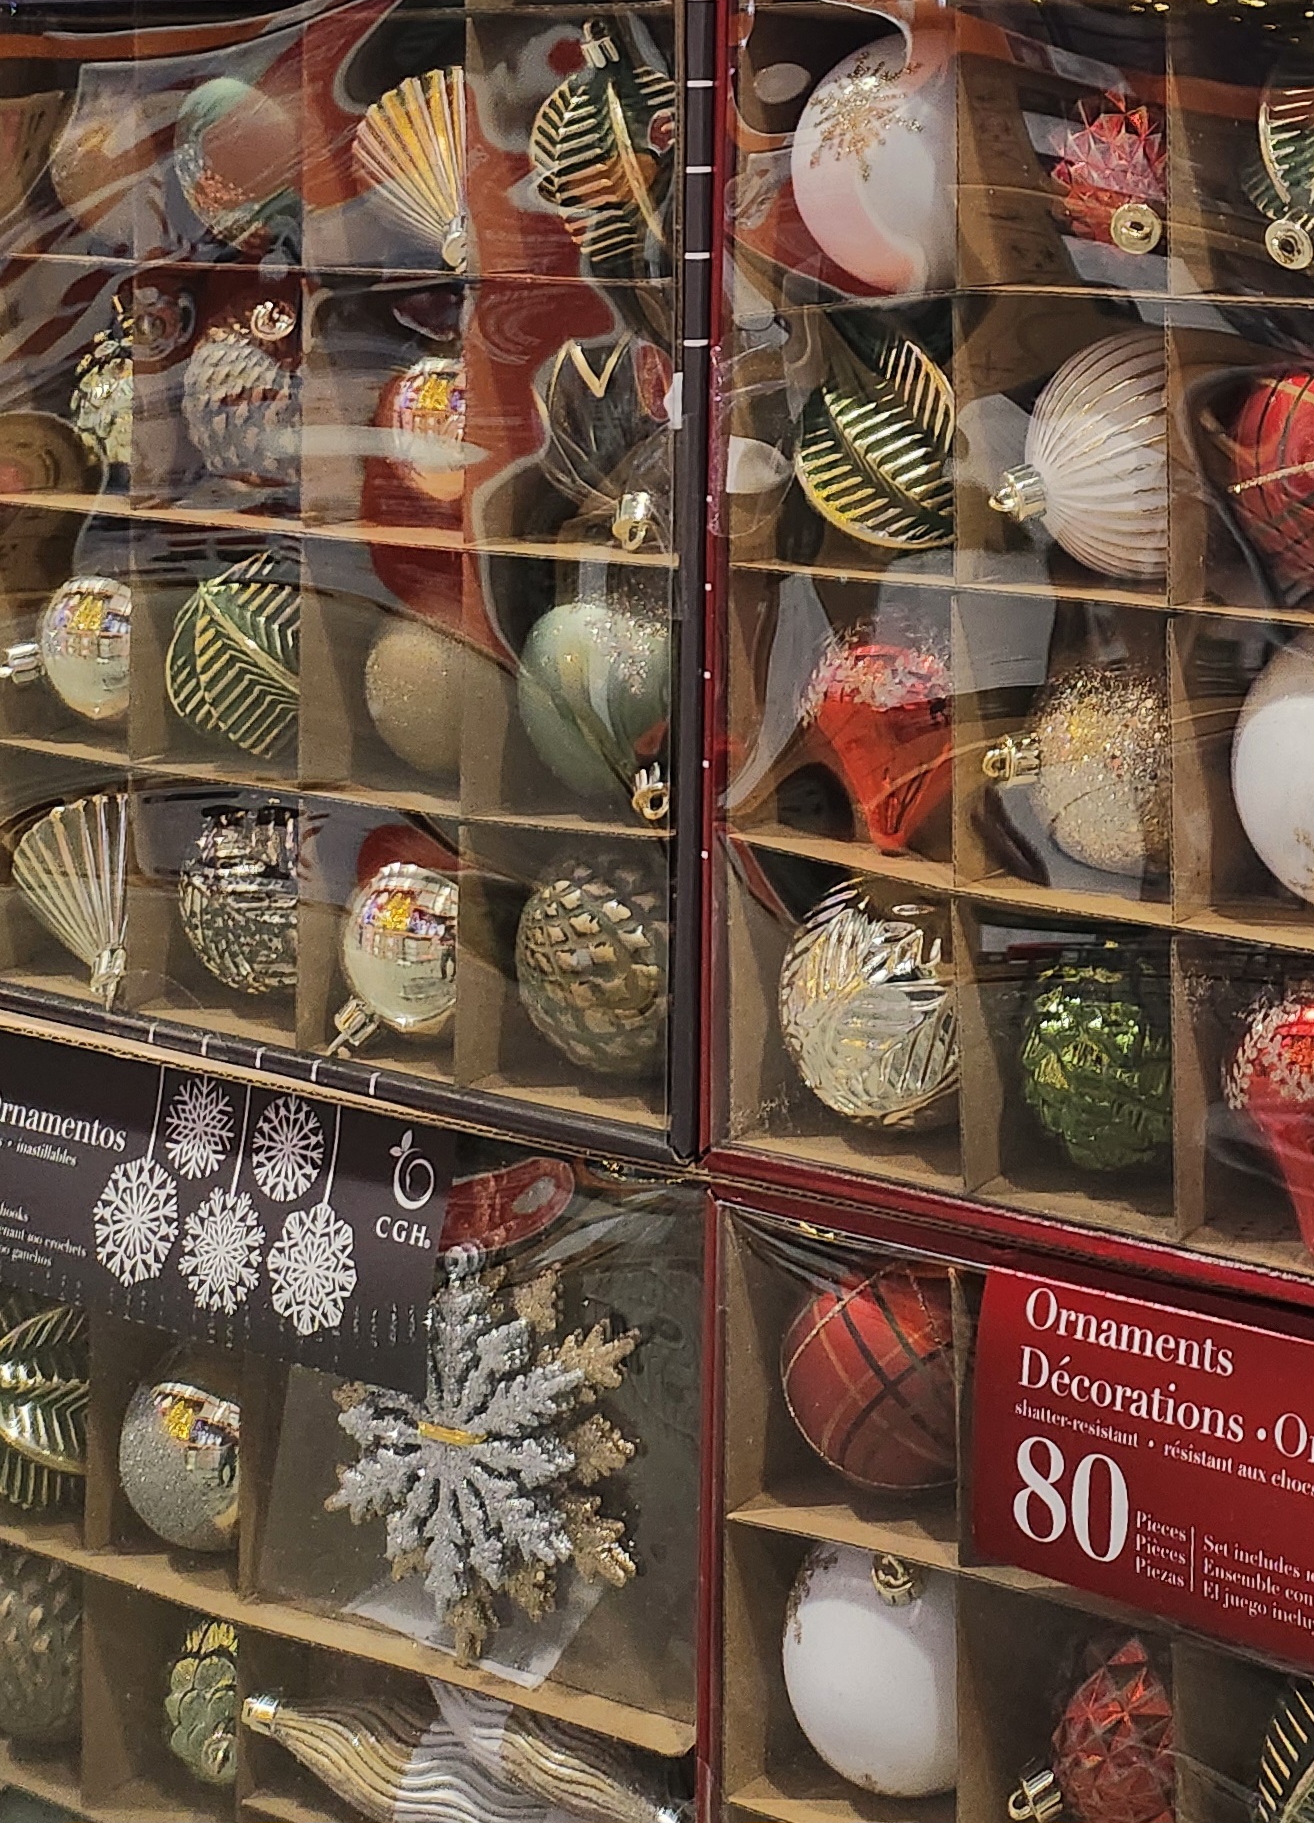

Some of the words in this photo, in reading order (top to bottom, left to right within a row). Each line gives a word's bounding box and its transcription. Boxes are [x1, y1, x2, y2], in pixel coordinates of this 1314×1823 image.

[0, 1095, 127, 1153] rnamentos
[1025, 1287, 1235, 1378] Ornaments
[1018, 1345, 1245, 1445] Décorations
[1015, 1399, 1140, 1449] shatter-resistant
[1163, 1440, 1234, 1476] résistant
[1238, 1464, 1268, 1485] aux
[1012, 1435, 1129, 1563] 80
[1135, 1533, 1187, 1566] Pièces
[1202, 1557, 1281, 1598] Ensemble
[1136, 1510, 1187, 1543] Pieces
[1203, 1534, 1230, 1558] Set
[1234, 1542, 1301, 1580] includes
[1135, 1556, 1185, 1589] Piezas
[1202, 1580, 1220, 1602] El
[1222, 1587, 1268, 1618] juego
